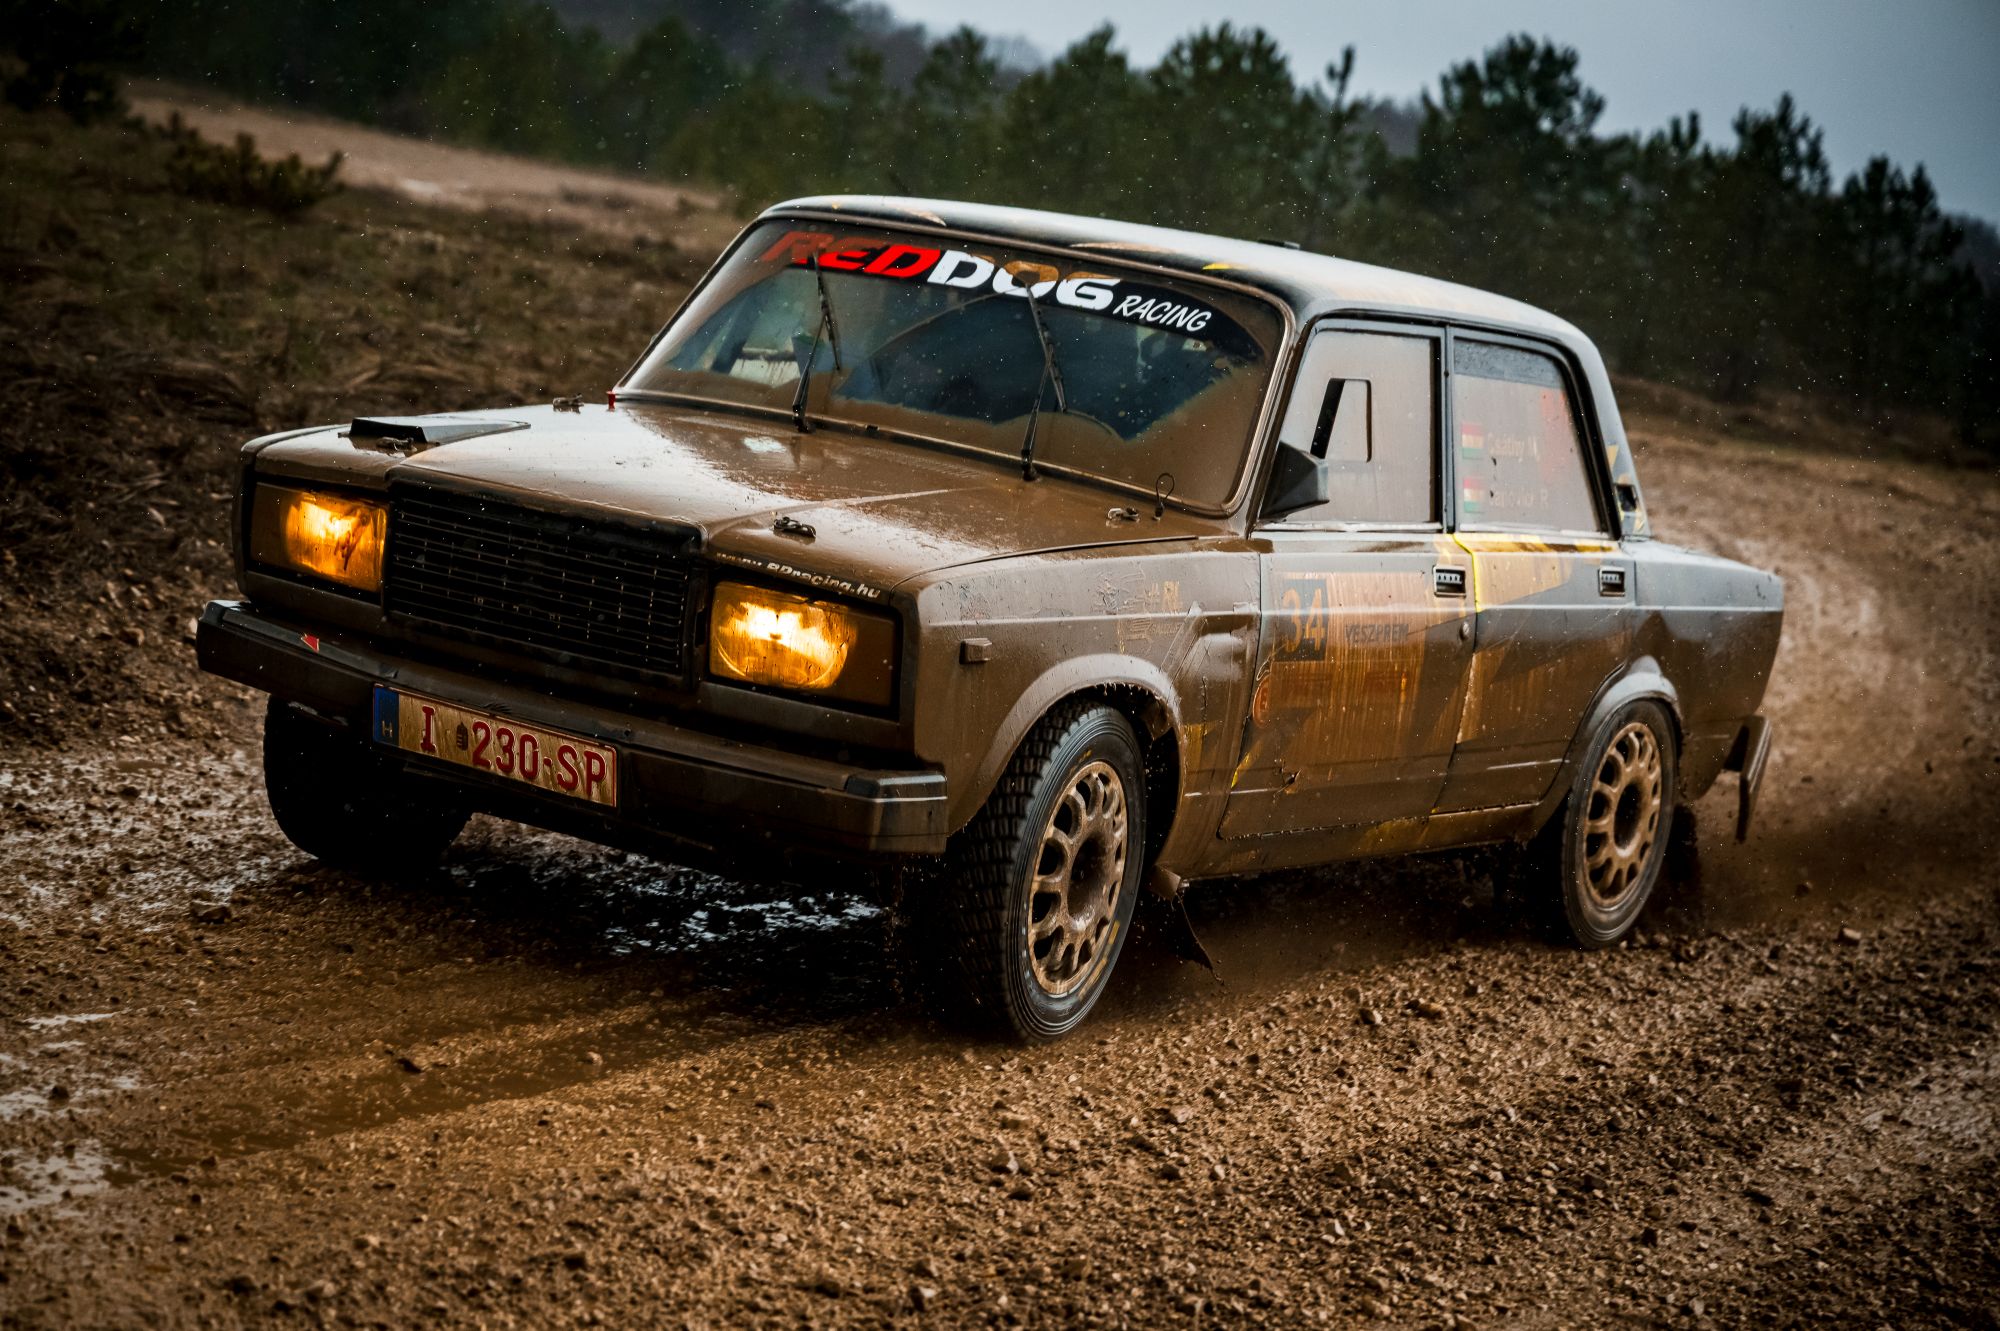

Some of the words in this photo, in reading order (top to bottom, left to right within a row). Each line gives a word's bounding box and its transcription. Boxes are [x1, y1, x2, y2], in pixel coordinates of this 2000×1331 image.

[1113, 295, 1212, 332] RACING
[1282, 588, 1327, 652] 34
[472, 720, 607, 797] 230-SP
